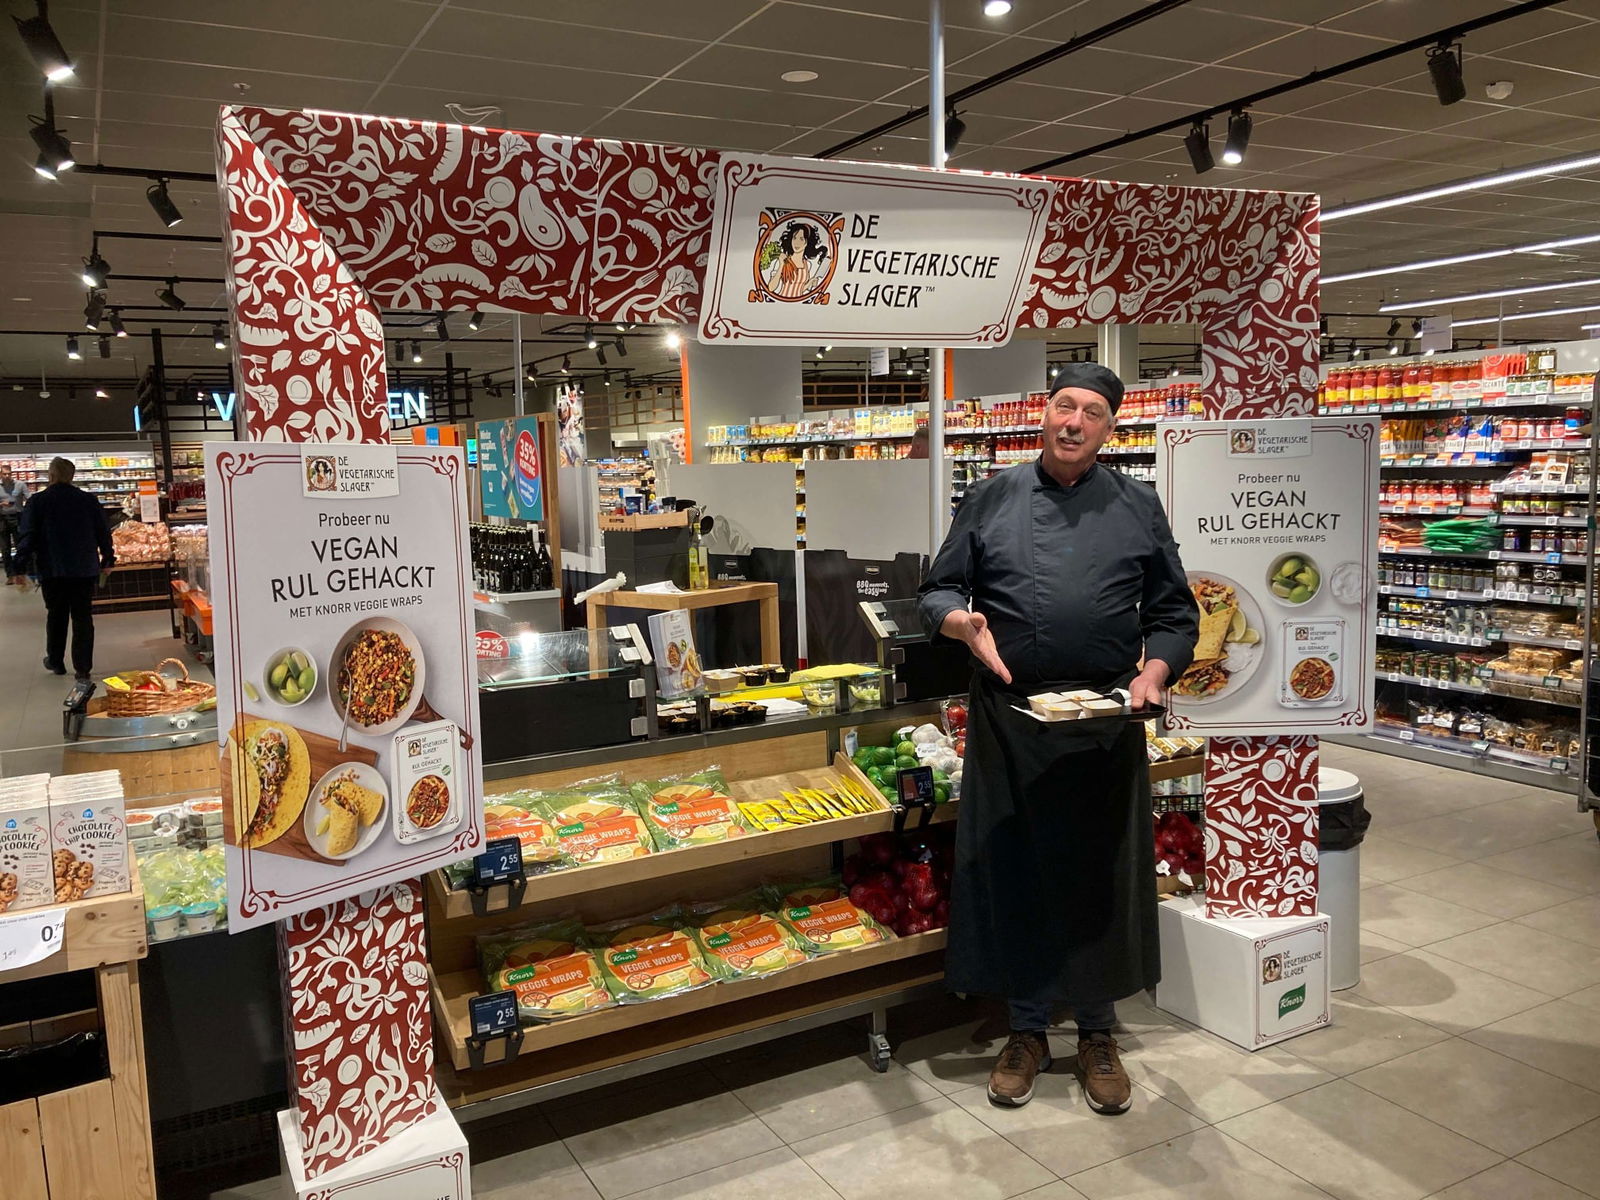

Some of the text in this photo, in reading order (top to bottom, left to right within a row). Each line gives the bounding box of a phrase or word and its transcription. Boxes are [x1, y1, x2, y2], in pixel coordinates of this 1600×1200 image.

[850, 213, 880, 240] DE
[847, 248, 1000, 280] VEGETARISCHE
[1257, 428, 1267, 436] DE
[1258, 436, 1308, 445] VEGETARISCHE
[338, 456, 349, 466] DE
[339, 469, 395, 479] VEGETARISCHE
[1238, 473, 1300, 484] Probeer nu
[1231, 491, 1306, 509] VEGAN
[319, 513, 390, 527] Probeer nu
[1198, 512, 1341, 534] RUL GEHACKT
[1210, 535, 1326, 545] MET KNORR VEGGIE WRAPS
[311, 536, 398, 564] VEGAN
[271, 566, 436, 603] RUL GEHACKT
[856, 580, 869, 588] BBQ
[865, 588, 879, 596] easy
[290, 595, 423, 619] MET KNORR VEGGIE WRAPS
[476, 649, 501, 657] ORTING
[693, 808, 723, 818] WRAPS
[68, 823, 113, 835] CHOCOLATE
[0, 833, 38, 842] OCOLATE
[81, 831, 117, 841] COOKIES
[566, 827, 631, 844] VEGGIE WRAPS
[5, 841, 41, 851] COOKIES
[790, 908, 810, 918] Knorr
[799, 911, 852, 929] VEGGIE WRAPS
[718, 934, 776, 956] VEGGIE WRAPS
[613, 951, 636, 962] Knorr
[1283, 950, 1290, 959] DE
[621, 952, 684, 973] VEGGIE WRAPS
[508, 971, 534, 980] Knorr
[517, 970, 584, 993] VEGGIE WRAPS
